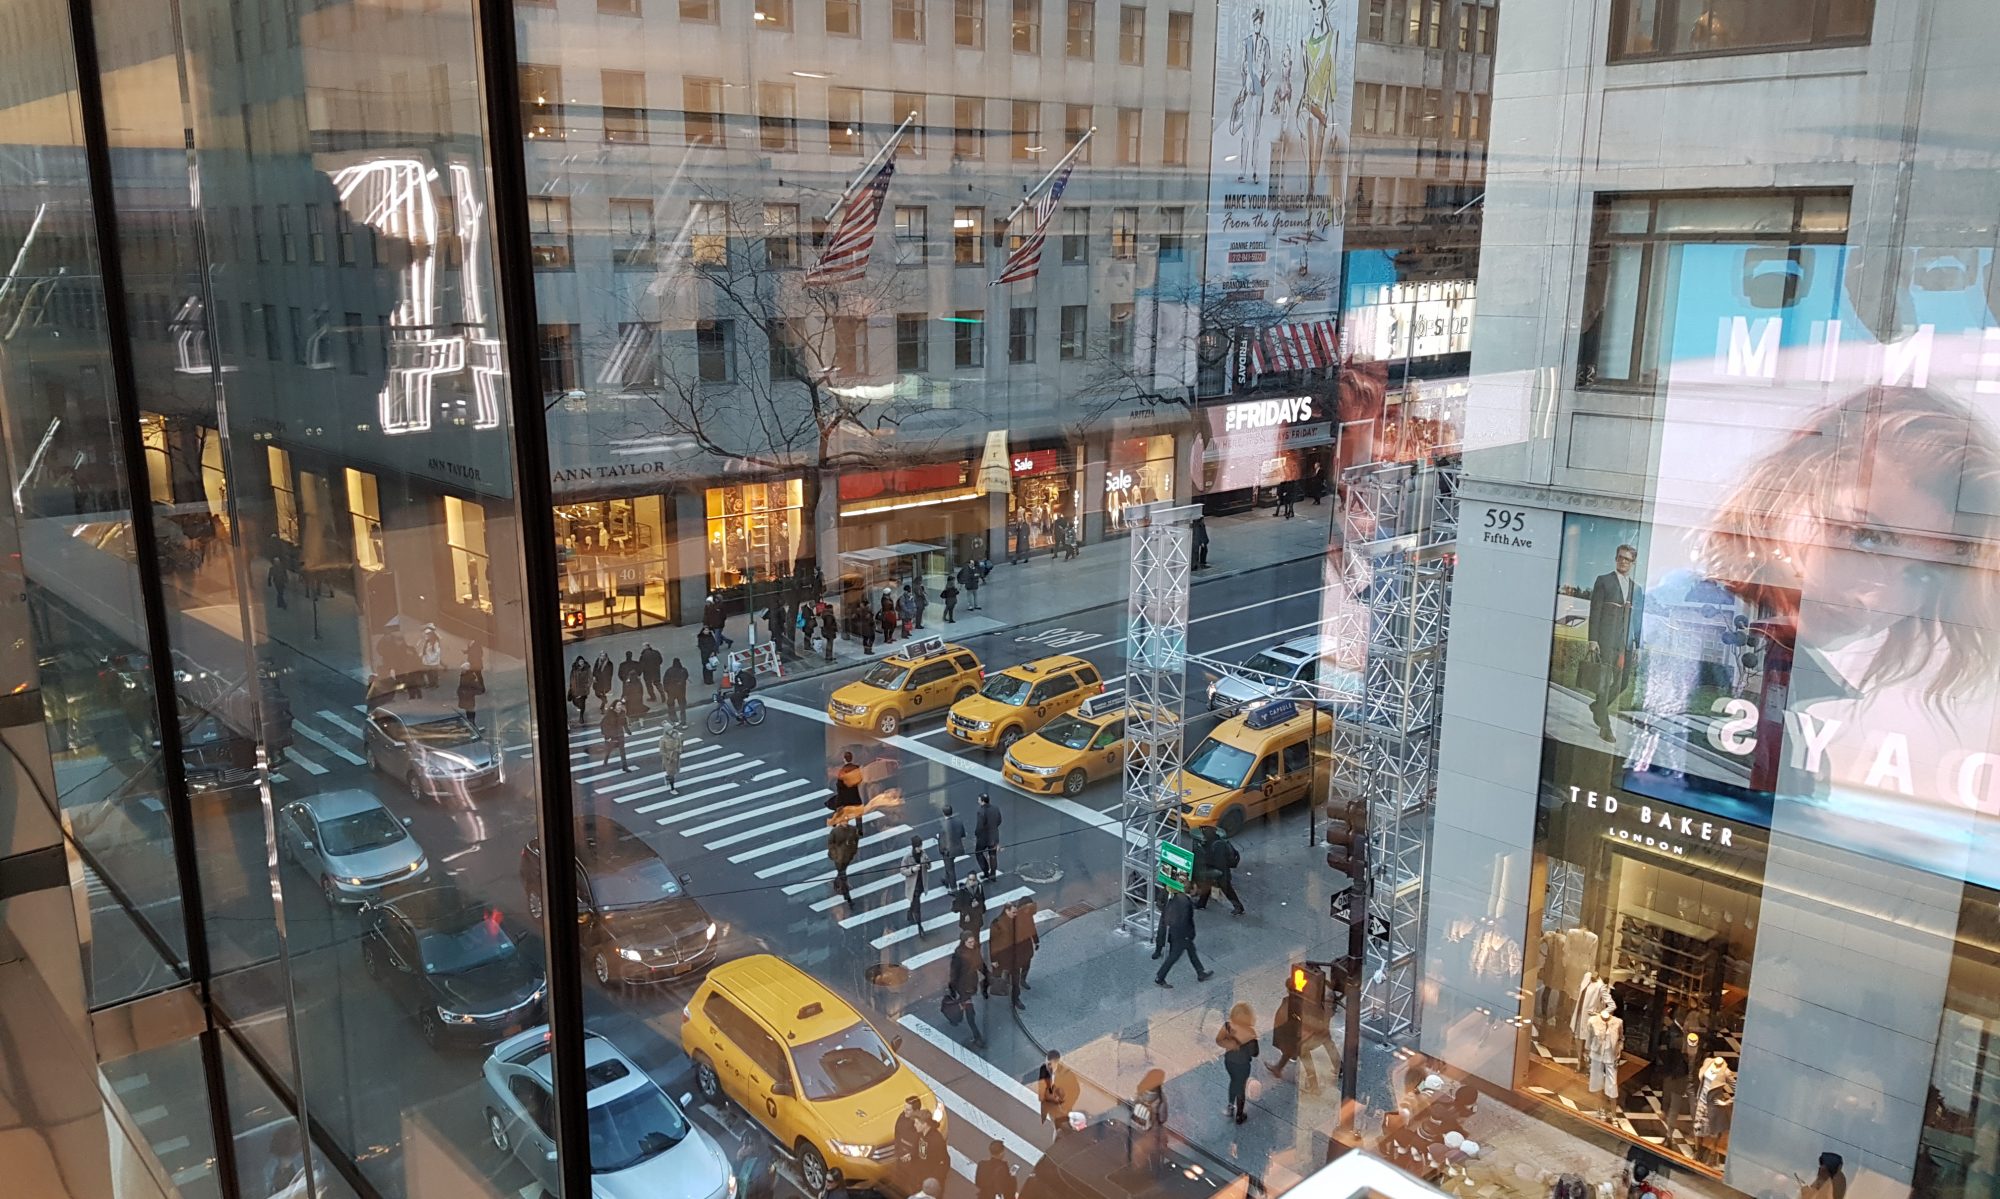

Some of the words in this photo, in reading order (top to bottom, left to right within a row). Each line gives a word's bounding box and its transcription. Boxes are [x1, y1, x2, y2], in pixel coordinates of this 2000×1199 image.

[1224, 194, 1246, 209] MAKE
[1248, 194, 1267, 209] YOUR
[1267, 194, 1304, 210] PRESENCE
[1222, 211, 1250, 232] From
[1252, 211, 1269, 228] the
[1272, 212, 1312, 236] Ground
[1316, 211, 1330, 233] Up
[1238, 340, 1248, 384] FRIDAYS
[1226, 406, 1236, 432] TGI
[1236, 396, 1312, 430] FRIDAYS
[428, 457, 445, 471] ANN
[447, 462, 481, 480] TAYLOR
[553, 468, 592, 482] ANN
[597, 461, 664, 477] TAYLOR
[1014, 458, 1034, 472] Sale
[1106, 469, 1132, 491] Sale
[1484, 509, 1525, 531] 595
[1483, 531, 1509, 545] Fifth
[1511, 536, 1532, 548] Ave
[620, 568, 636, 580] 40
[1269, 702, 1293, 716] CAPSULE
[1570, 786, 1618, 813] TED
[1641, 806, 1732, 847] BAKER
[1609, 827, 1683, 855] LONDON
